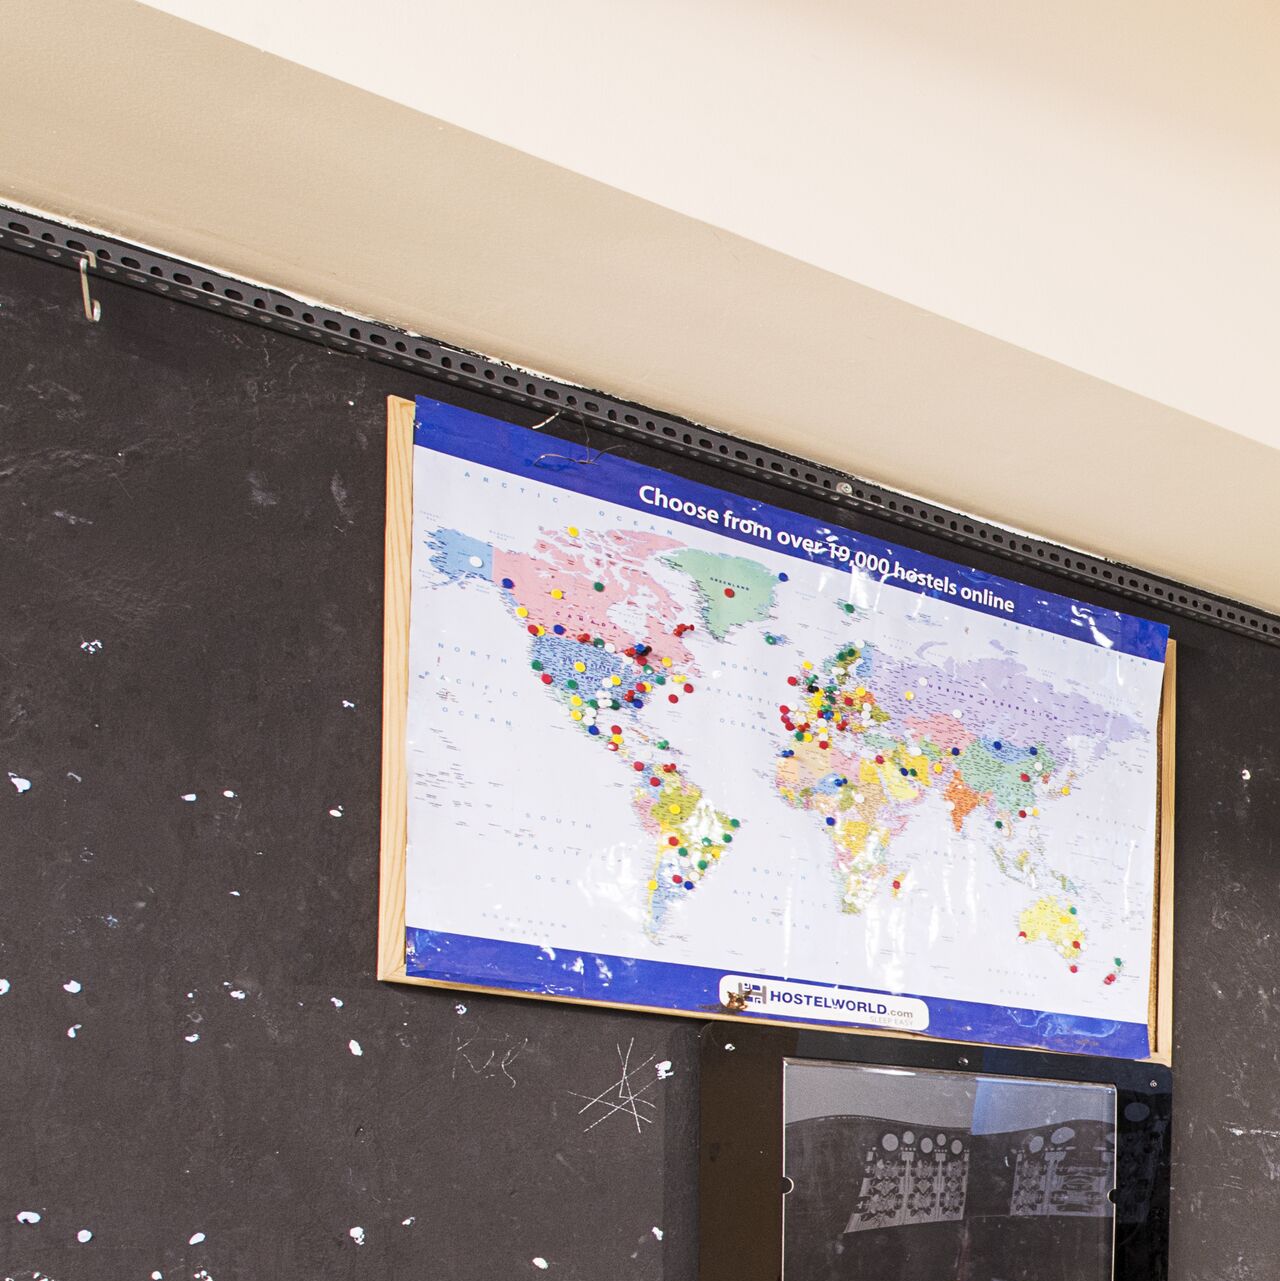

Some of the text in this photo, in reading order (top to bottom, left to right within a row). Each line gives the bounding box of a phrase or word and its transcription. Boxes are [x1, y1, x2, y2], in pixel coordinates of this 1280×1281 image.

[638, 484, 1015, 613] Choose from over 19,000 hostels online
[769, 989, 914, 1019] HOSTELWORLD.com
